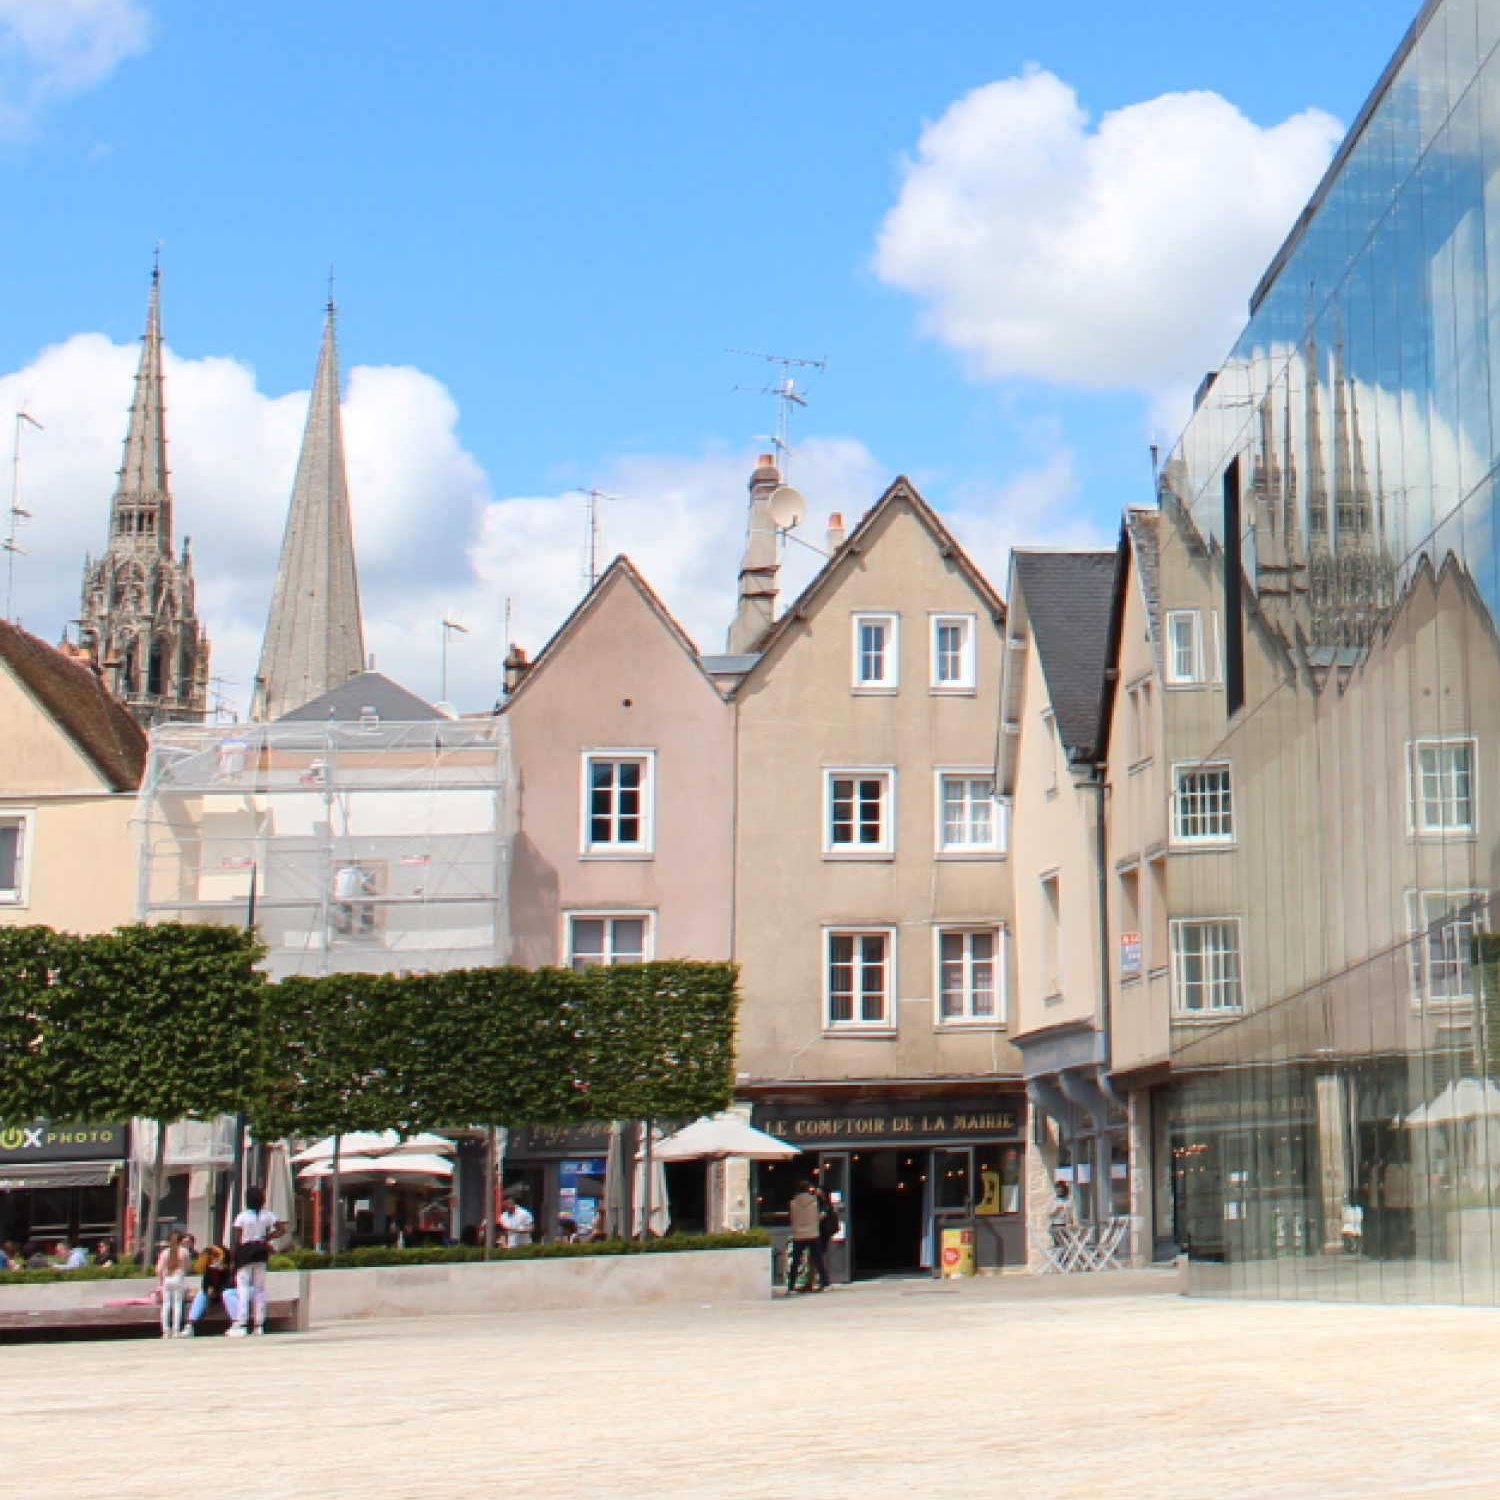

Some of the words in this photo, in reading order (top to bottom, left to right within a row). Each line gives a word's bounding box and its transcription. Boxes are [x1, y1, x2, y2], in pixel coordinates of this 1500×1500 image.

[764, 1120, 787, 1136] LE
[795, 1118, 885, 1136] COMPTOIR
[892, 1116, 913, 1132] DE
[922, 1115, 946, 1132] LA
[953, 1114, 1013, 1129] MAIRIE
[47, 1131, 113, 1143] PHOTO
